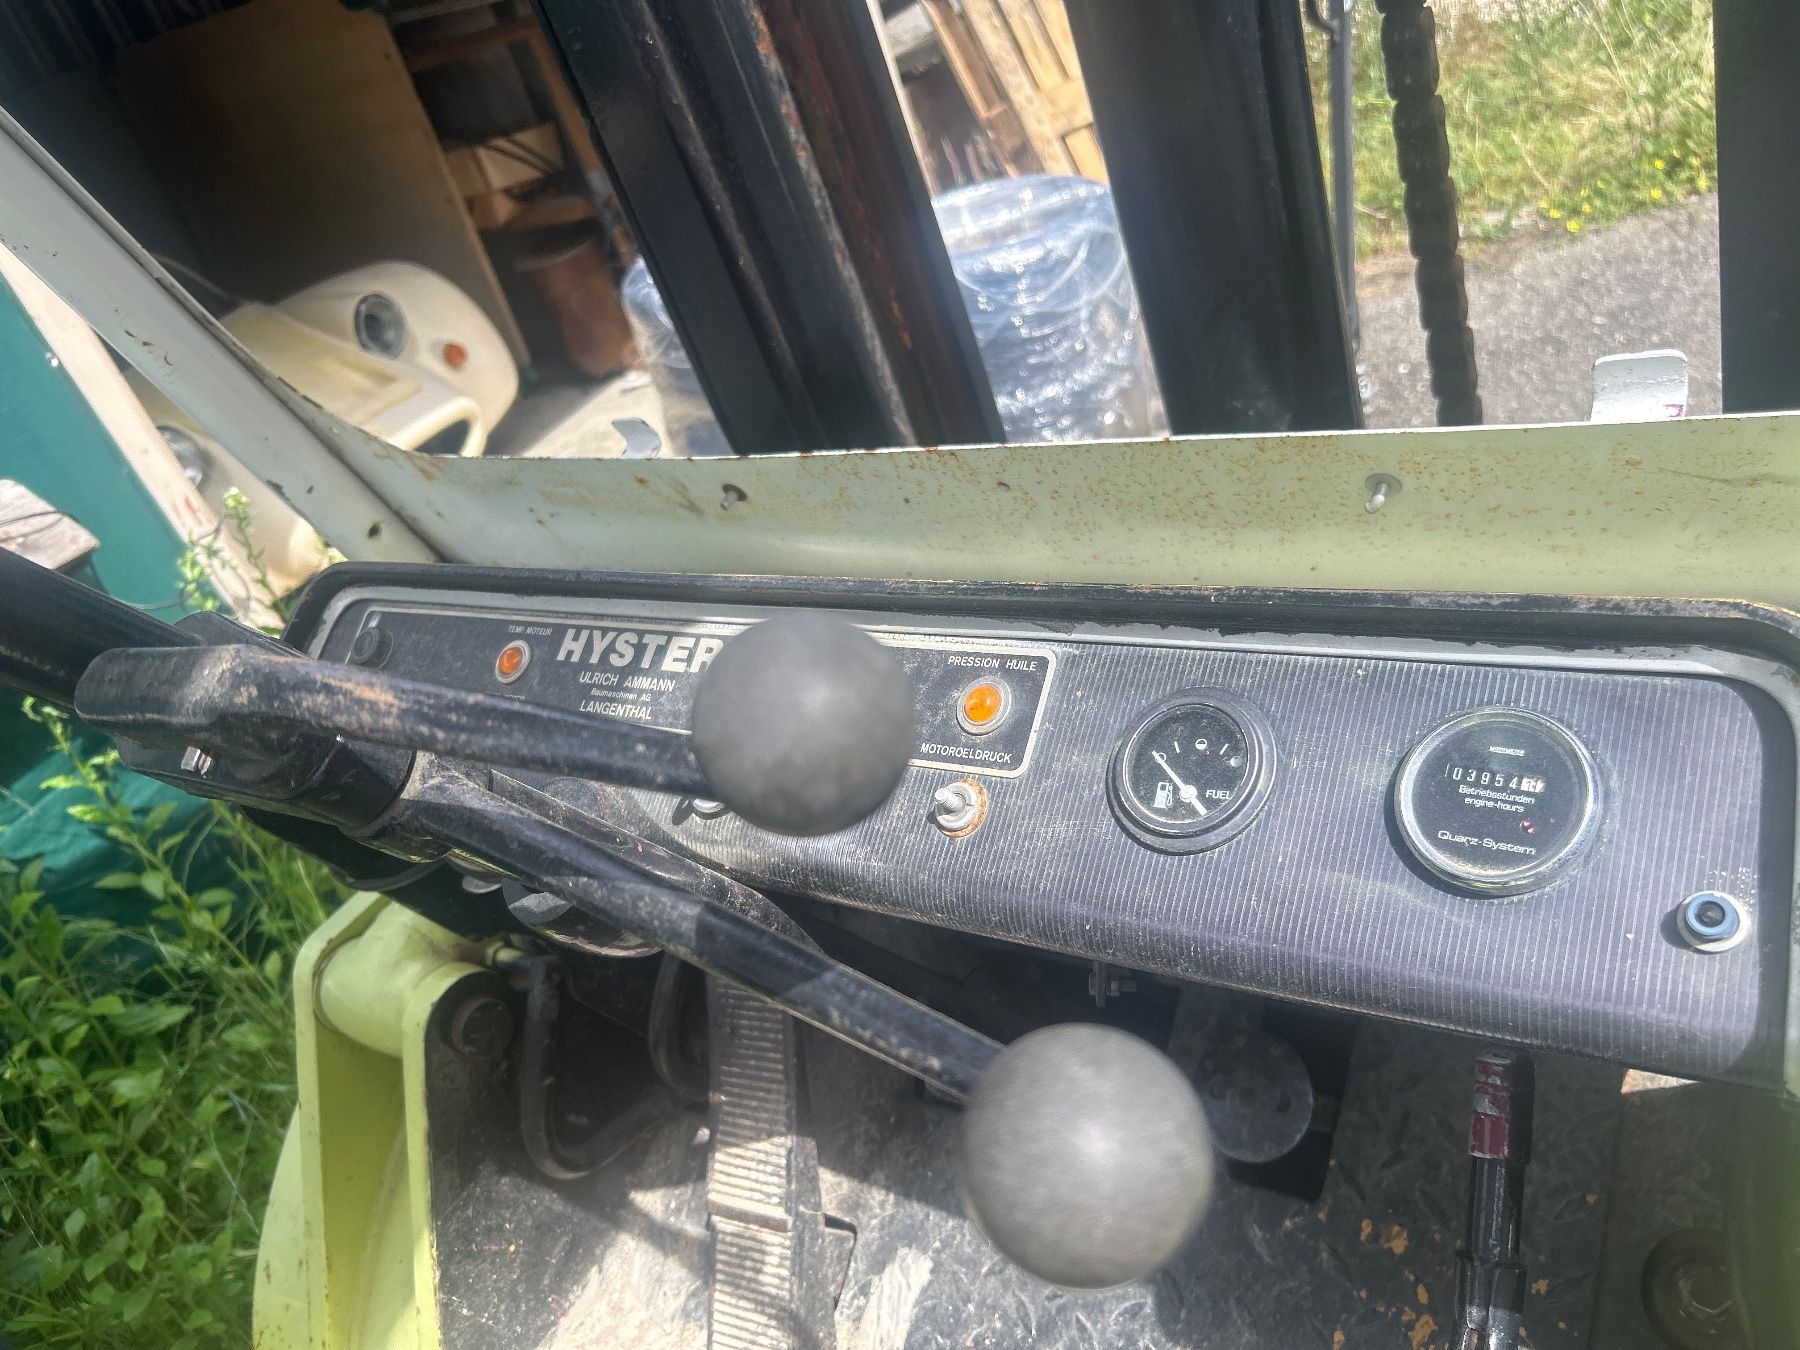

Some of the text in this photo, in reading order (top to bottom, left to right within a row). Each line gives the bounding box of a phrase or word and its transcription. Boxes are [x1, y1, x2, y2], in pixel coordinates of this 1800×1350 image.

[526, 626, 553, 636] MOTEUR
[556, 628, 724, 673] HYSTER
[948, 655, 1038, 672] PRESSION HUILE
[579, 670, 676, 692] ULRICH AMMANN
[590, 687, 652, 702] Baumaschinen AG
[579, 699, 652, 720] LANGENTHAL
[920, 742, 1013, 764] MOTOROELDRUCK
[1205, 789, 1232, 800] FUEL
[1458, 784, 1536, 805] Betriebsstunden
[1464, 796, 1525, 813] engine-hours
[1437, 830, 1537, 856] Quarz-System
